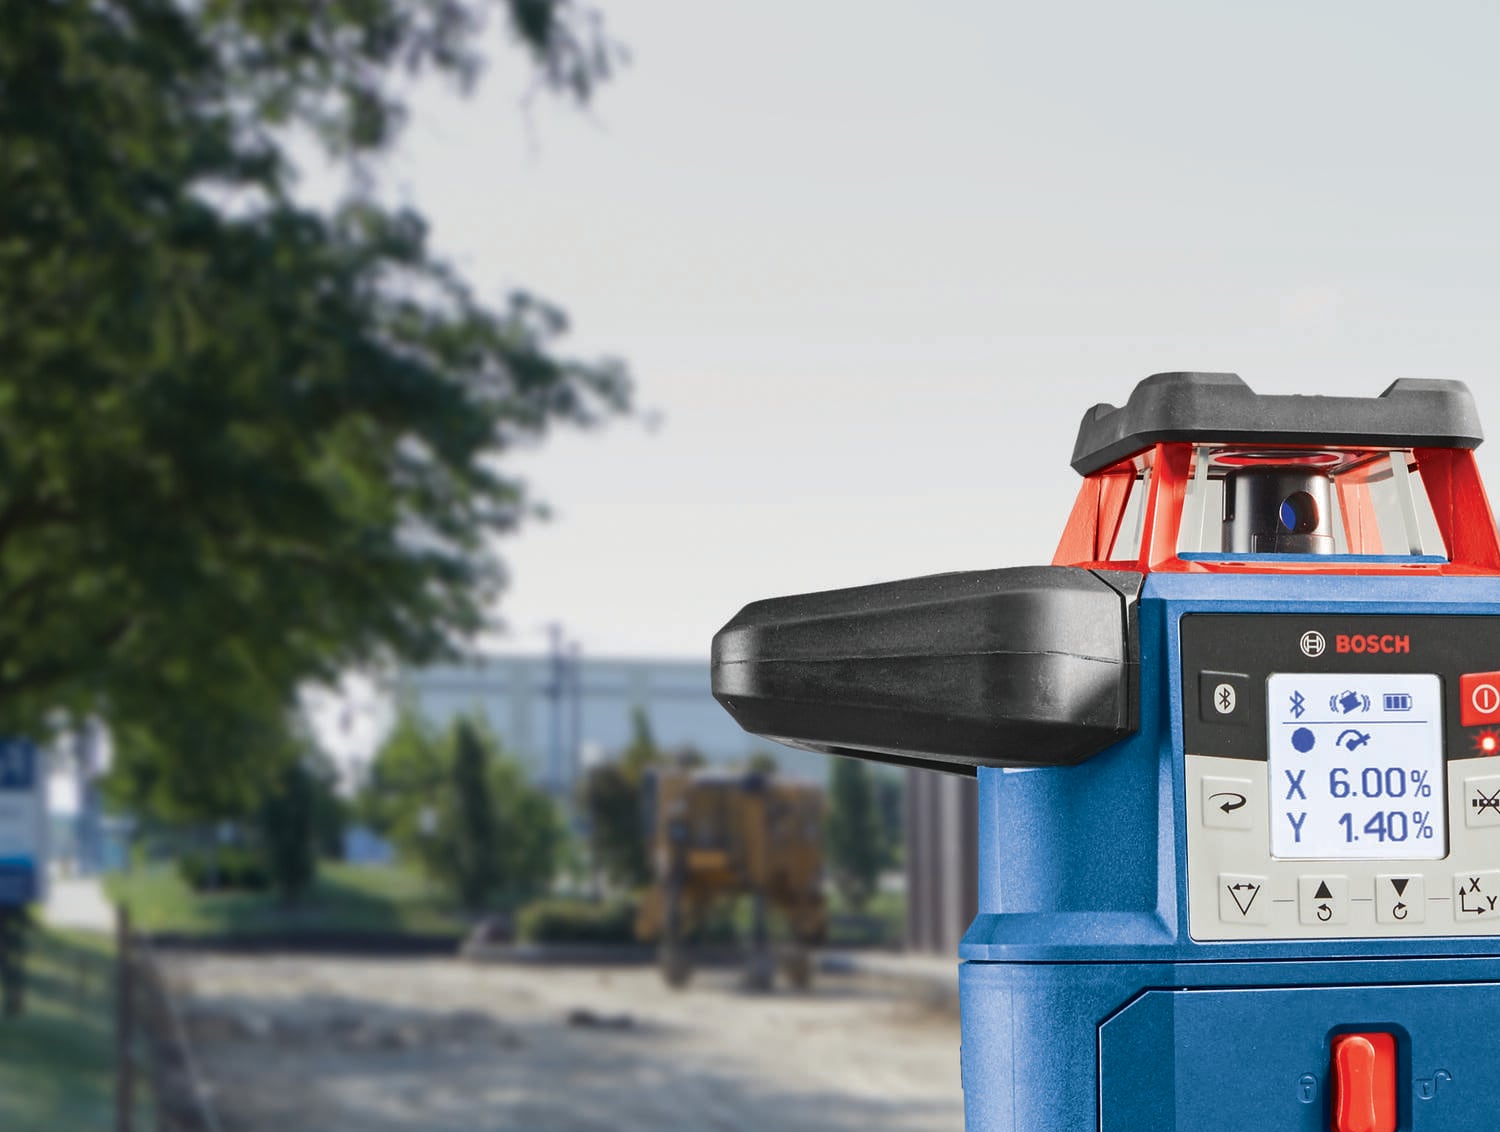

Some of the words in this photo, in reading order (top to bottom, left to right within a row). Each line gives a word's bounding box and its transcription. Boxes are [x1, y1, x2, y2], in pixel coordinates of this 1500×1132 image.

[1335, 635, 1410, 653] BOSCH
[1285, 770, 1306, 800] X
[1329, 767, 1432, 799] 6.00%
[1286, 812, 1307, 843] Y
[1338, 810, 1434, 843] 1.40%
[1468, 877, 1481, 893] X
[1486, 895, 1498, 910] Y
